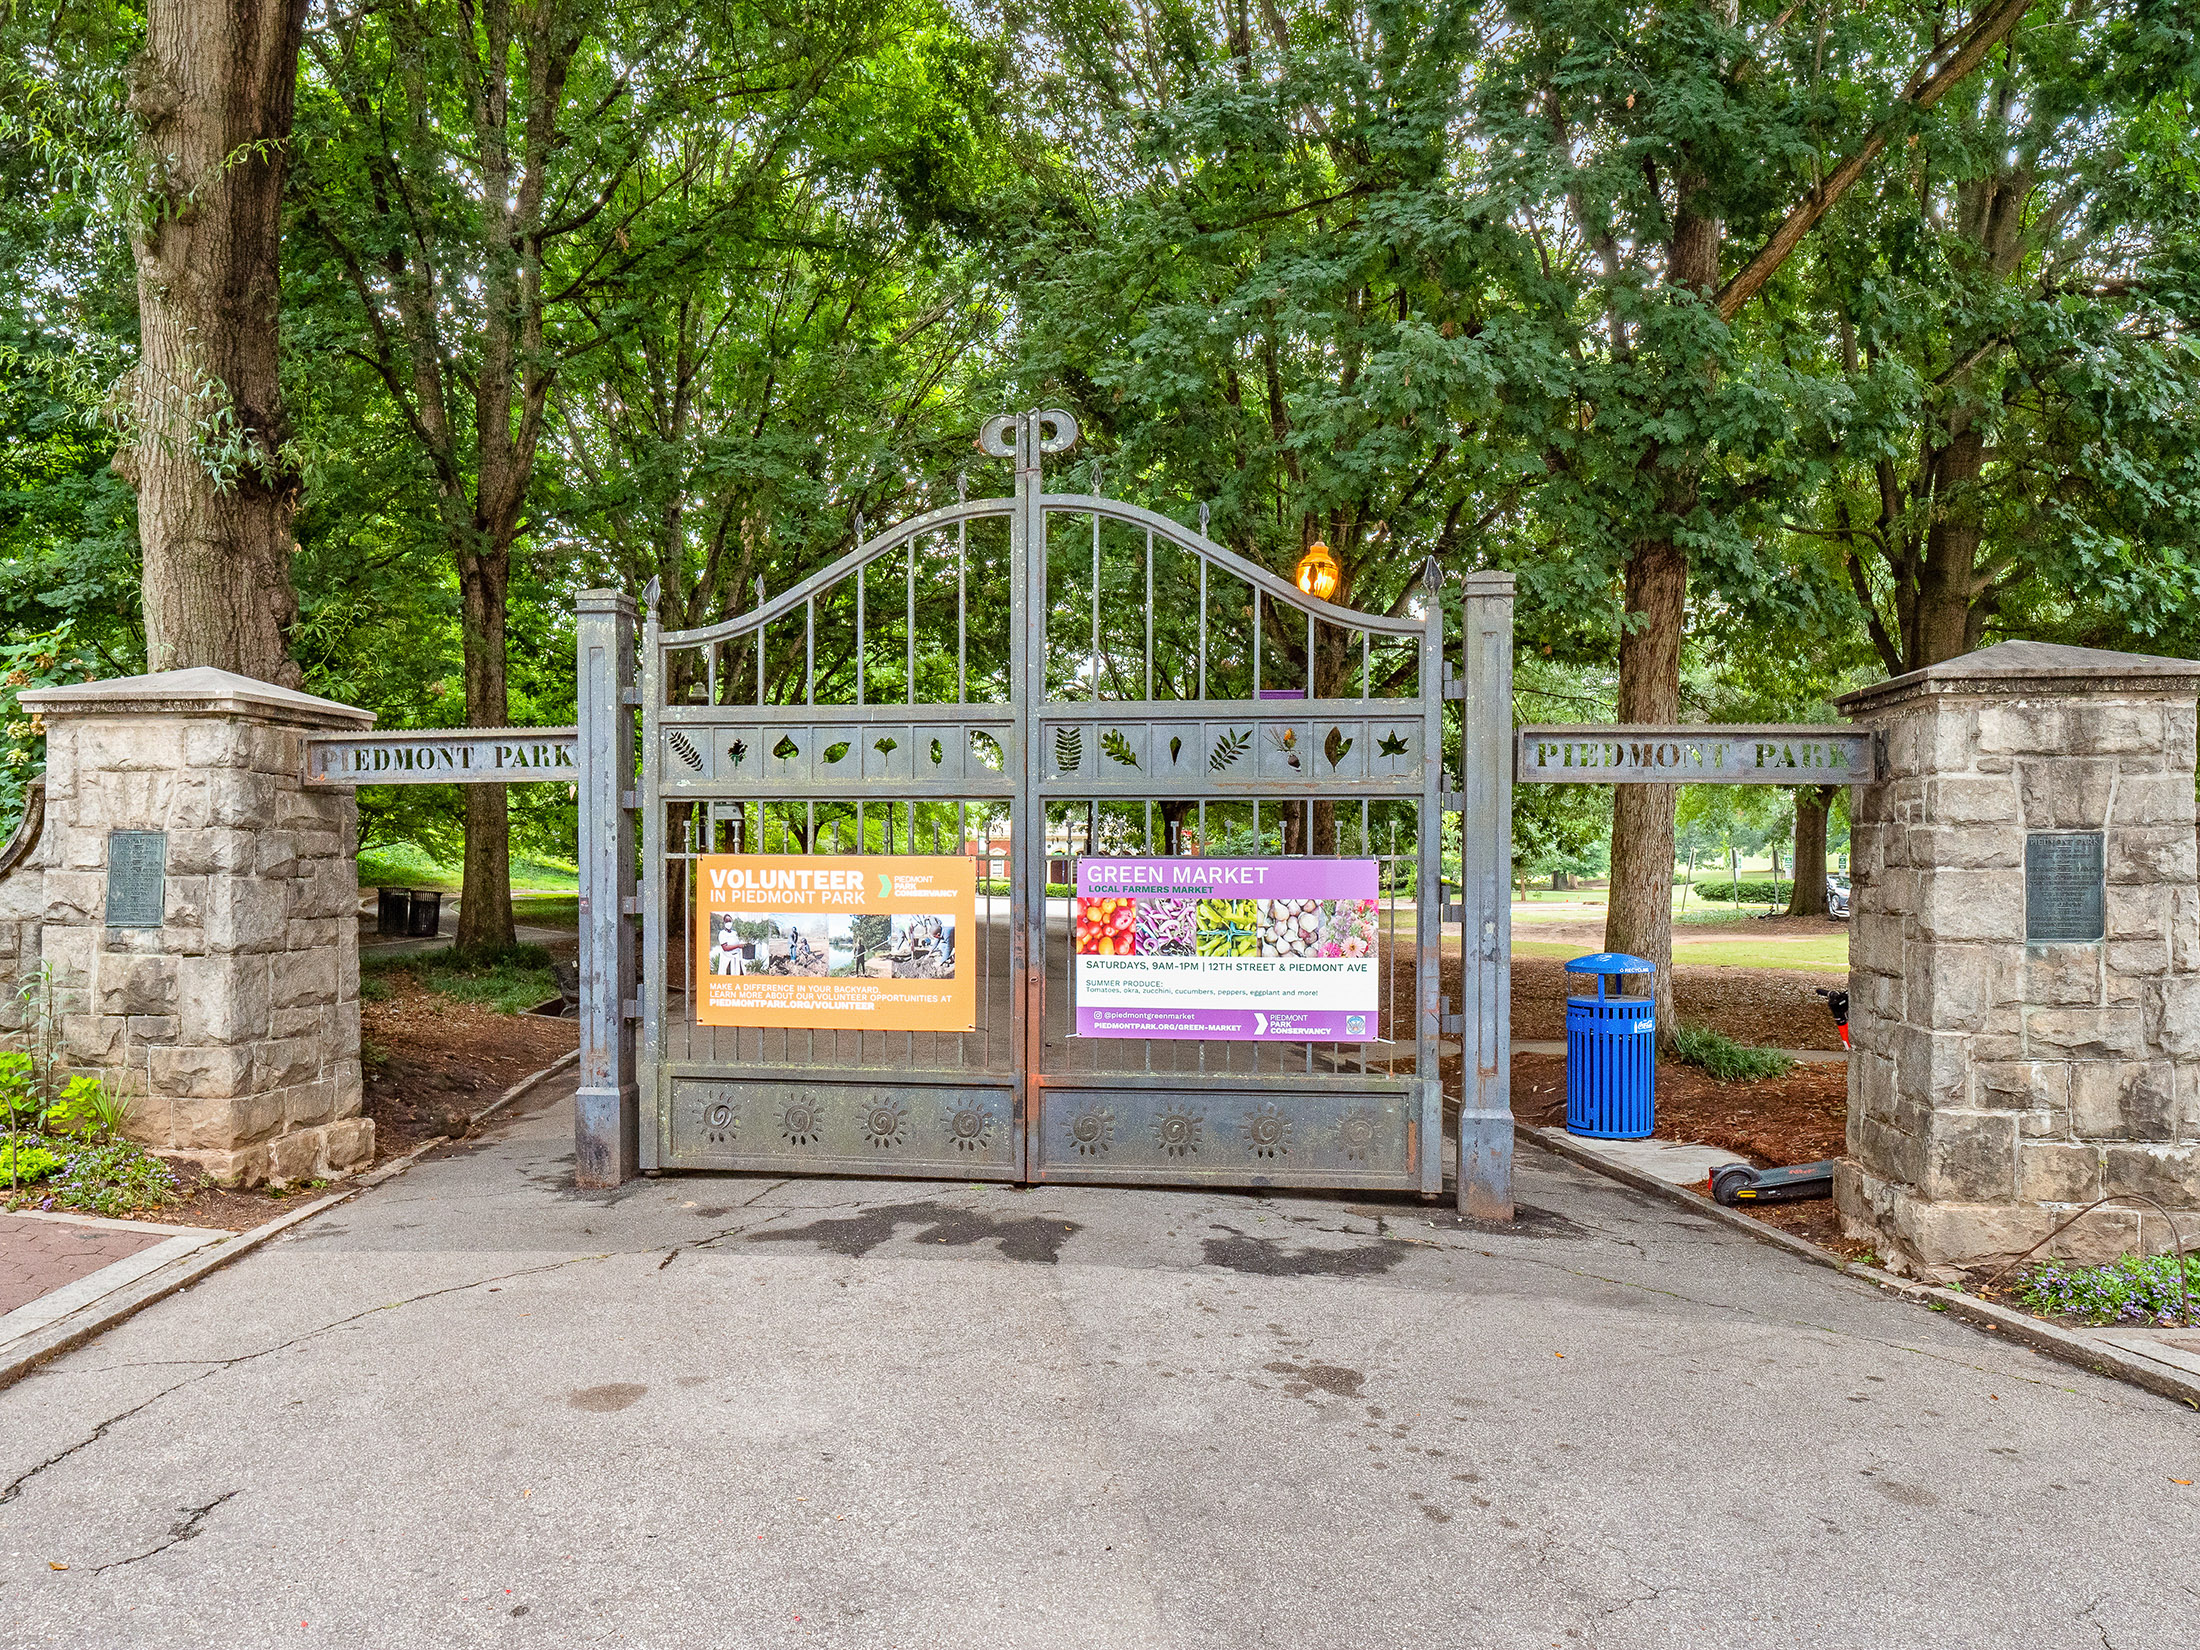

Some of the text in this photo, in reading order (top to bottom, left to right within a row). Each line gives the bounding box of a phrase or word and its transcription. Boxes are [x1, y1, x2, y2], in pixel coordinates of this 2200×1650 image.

[321, 744, 574, 772] PIEDMONT PARK
[1536, 743, 1851, 769] PIEDMONT PARK
[709, 868, 864, 891] VOLUNTEER
[894, 875, 934, 884] PIEDMONT
[1087, 865, 1269, 885] GREEN MARKET
[894, 889, 958, 898] CONSERVANCY
[1088, 885, 1214, 894] LOCAL FARMERS MARKET
[710, 890, 866, 905] IN PIEDMONT PARK
[1086, 960, 1149, 971] SATURDAYS,
[1152, 962, 1199, 971] 9AM-1PM
[1208, 962, 1233, 971] 12TH
[1236, 963, 1276, 972] STREET
[1279, 963, 1286, 972] &
[1289, 963, 1344, 972] PIEDMONT
[1347, 964, 1368, 972] AVE
[709, 983, 733, 991] MAKE
[743, 984, 795, 993] DIFFERENCE
[797, 985, 806, 993] IN
[808, 985, 832, 993] YOUR
[834, 985, 881, 994] BACKYARD.
[1085, 979, 1164, 988] SUMMER PRODUCE:
[709, 991, 952, 1003] LEARN MORE ABOUT OUR VOLUNTEER OPPORTUNITIES AT
[1086, 986, 1122, 994] Tomatoes,
[1123, 987, 1141, 995] okra,
[1142, 987, 1173, 995] zucchini,
[1175, 988, 1215, 996] cucumbers,
[1218, 989, 1248, 997] peppers,
[1250, 989, 1280, 997] eggplant
[709, 999, 875, 1011] PIEDMONTPARK.ORG/VOLUNTEER
[1104, 1011, 1195, 1020] @piedmontgreenmarket
[1094, 1022, 1242, 1032] PIEDMONTPARK.ORG/GREEN-MARKET
[1270, 1027, 1332, 1035] CONSERVANCY
